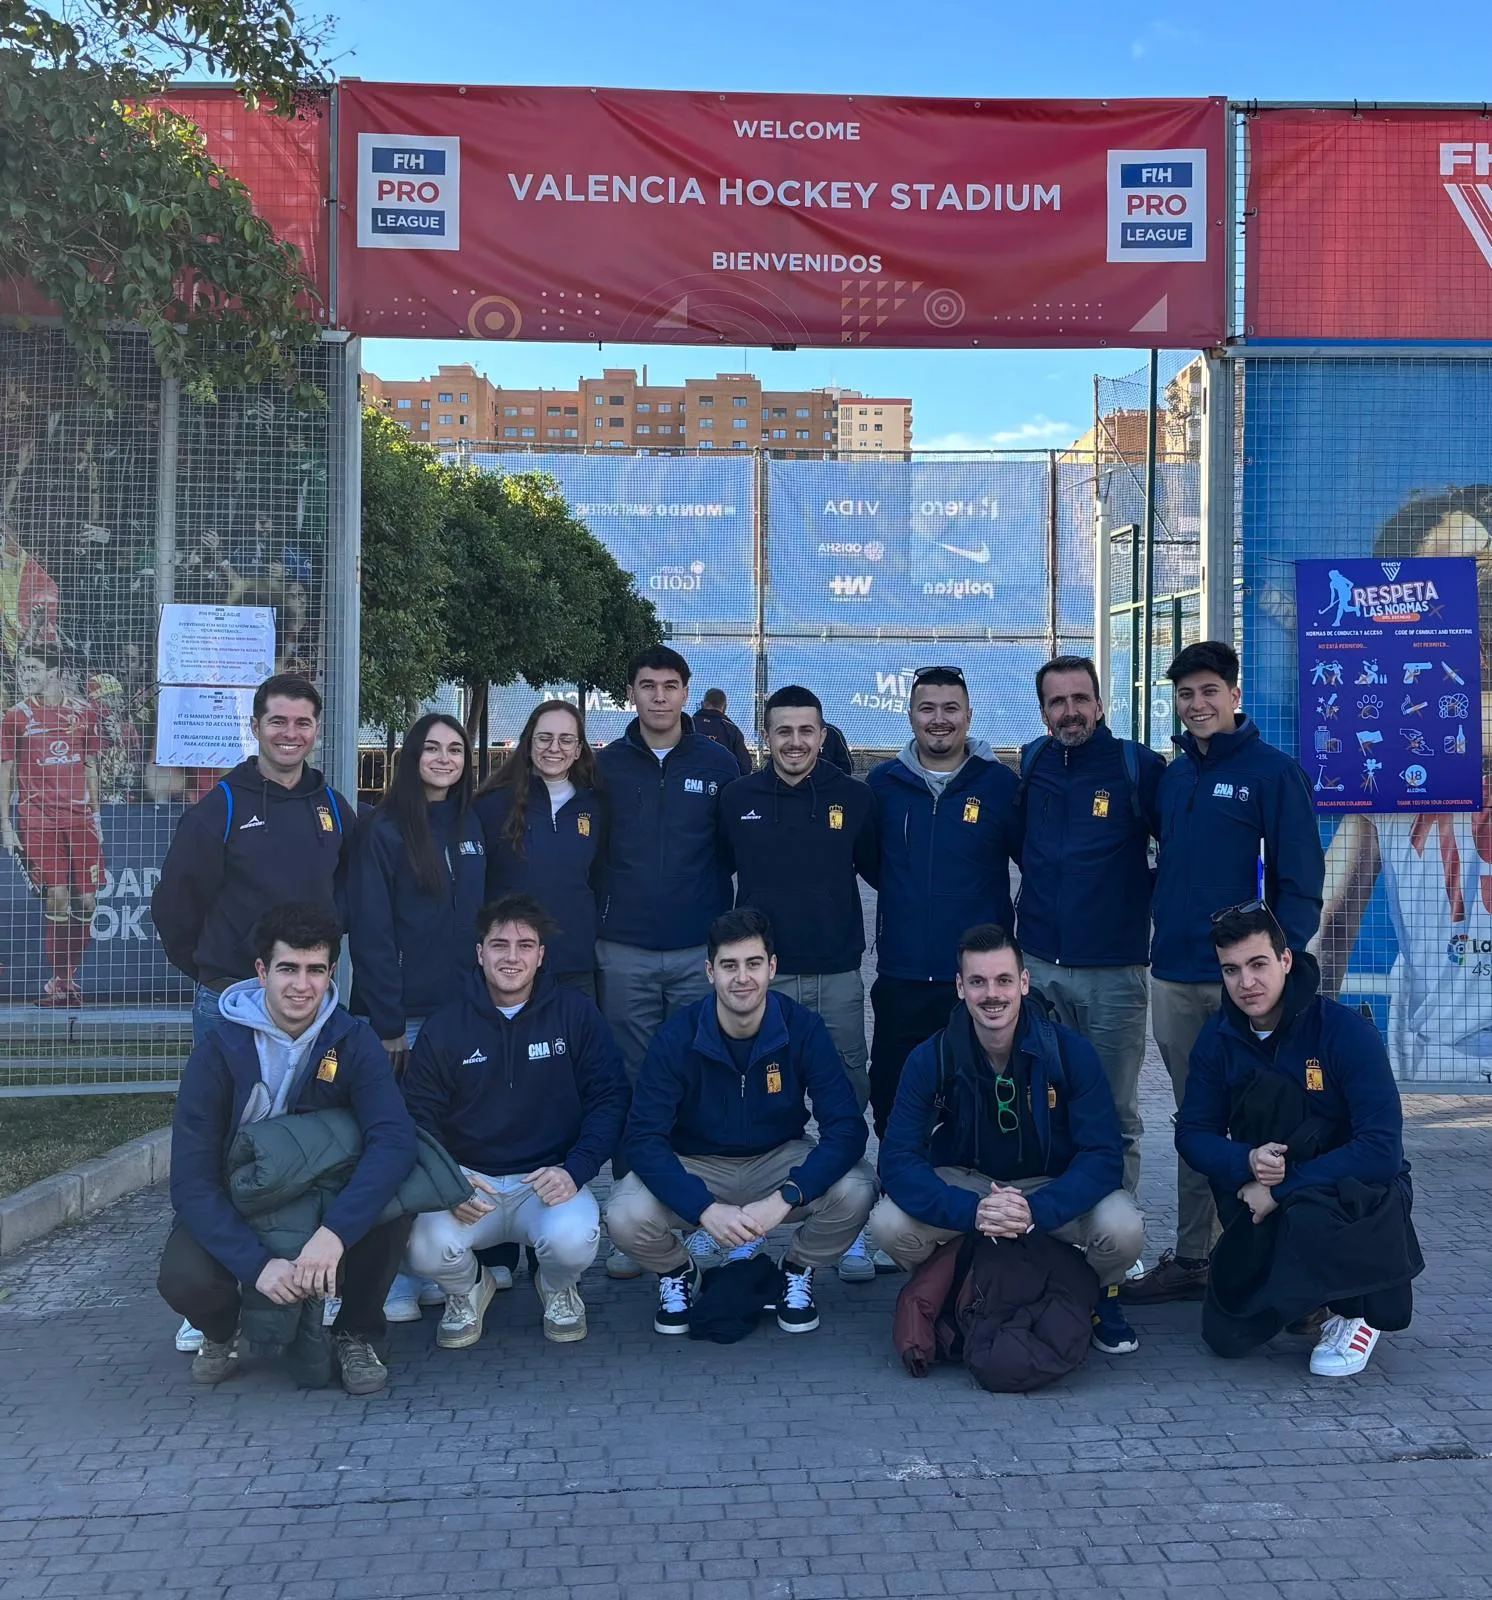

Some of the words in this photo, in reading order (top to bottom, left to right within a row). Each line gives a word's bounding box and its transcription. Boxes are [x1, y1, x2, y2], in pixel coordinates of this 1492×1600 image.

[733, 119, 861, 141] WELCOME
[377, 180, 440, 204] PRO
[508, 173, 706, 205] VALENCIA
[719, 177, 879, 210] HOCKEY
[890, 182, 1061, 212] STADIUM
[1126, 194, 1187, 216] PRO
[377, 213, 440, 229] LEAGUE
[1126, 227, 1187, 242] LEAGUE
[712, 251, 882, 274] BIENVENIDOS
[1353, 580, 1439, 607] RESPETA
[1363, 605, 1384, 618] LAS
[1384, 600, 1429, 616] NORMAS
